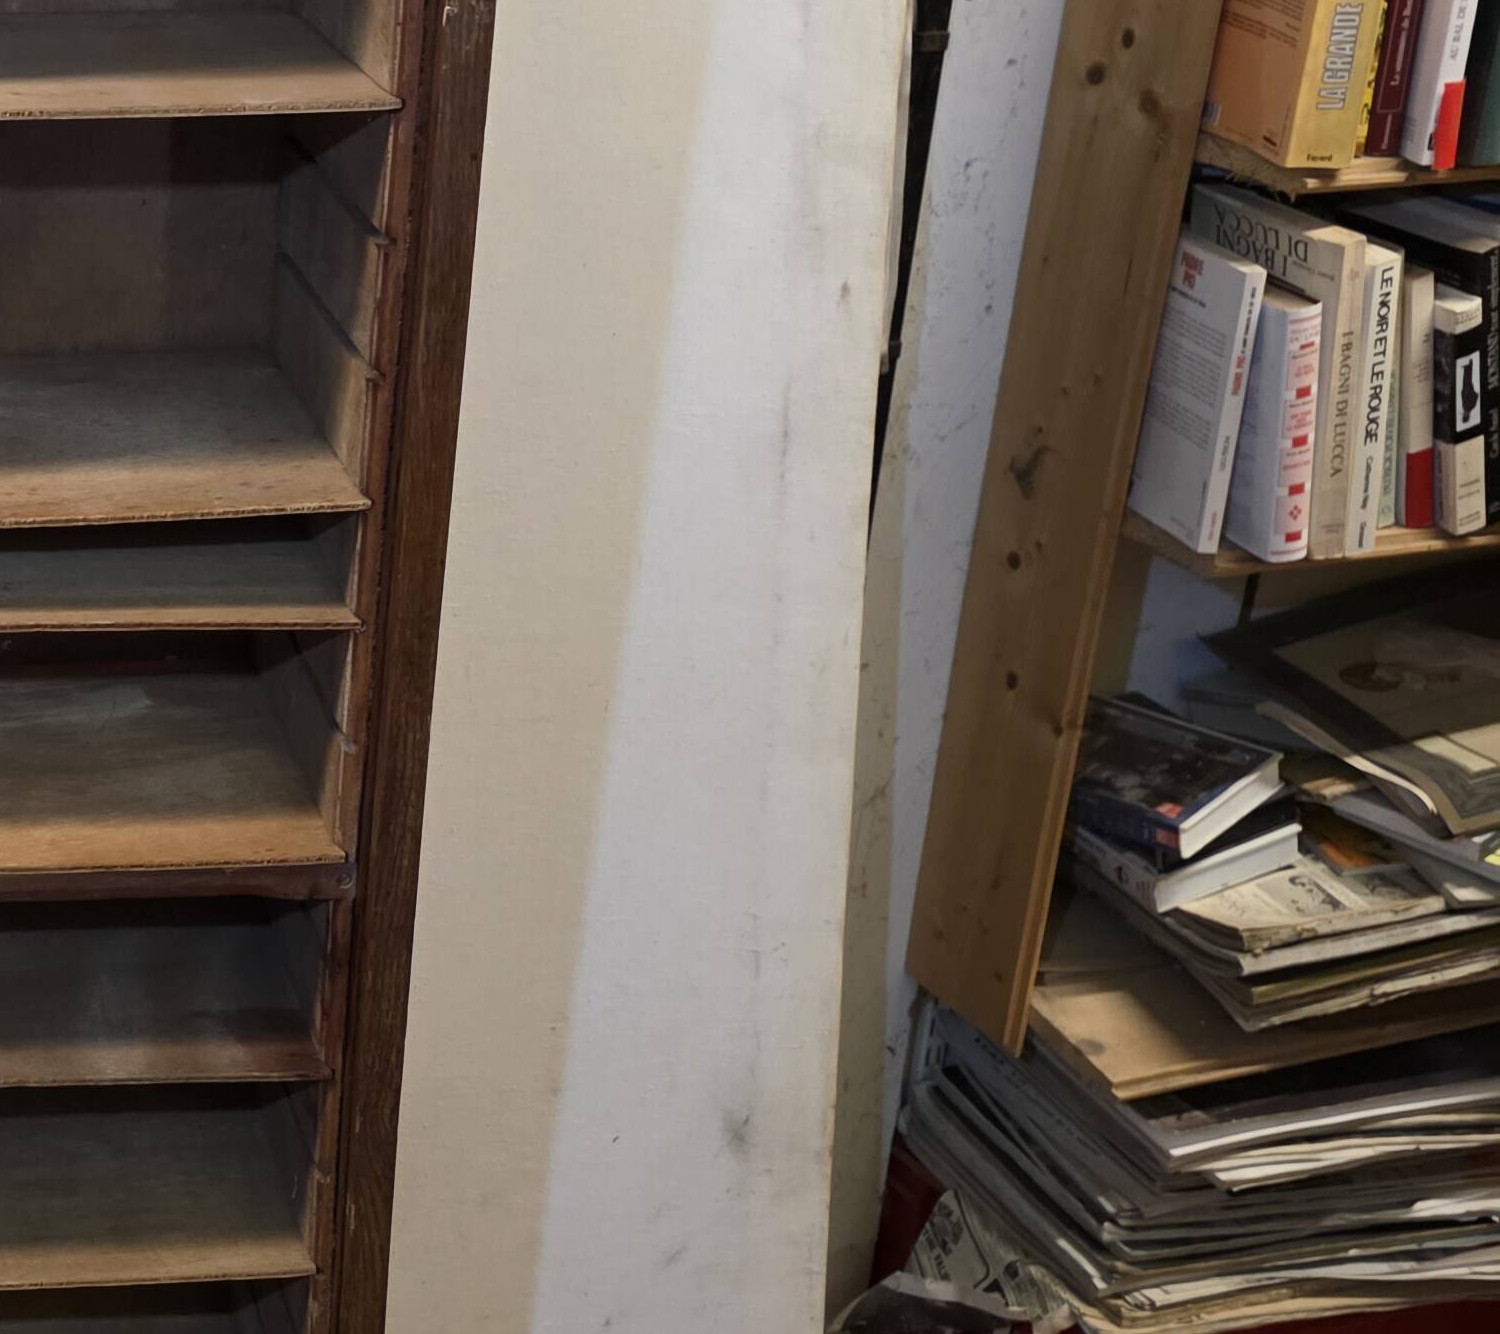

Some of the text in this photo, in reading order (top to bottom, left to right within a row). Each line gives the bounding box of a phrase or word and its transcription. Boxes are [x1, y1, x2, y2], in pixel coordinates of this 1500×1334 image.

[1457, 4, 1468, 20] DE
[1322, 3, 1365, 83] GRANDE
[1316, 86, 1347, 111] LA
[1213, 203, 1308, 264] DI LUCCA
[1216, 224, 1274, 271] BAGNI
[1282, 256, 1289, 278] I
[1337, 339, 1353, 396] BAGNI
[1364, 266, 1394, 447] LE NOIR ET LE ROUGE
[1334, 399, 1349, 417] DI
[1329, 421, 1348, 478] LUCCA
